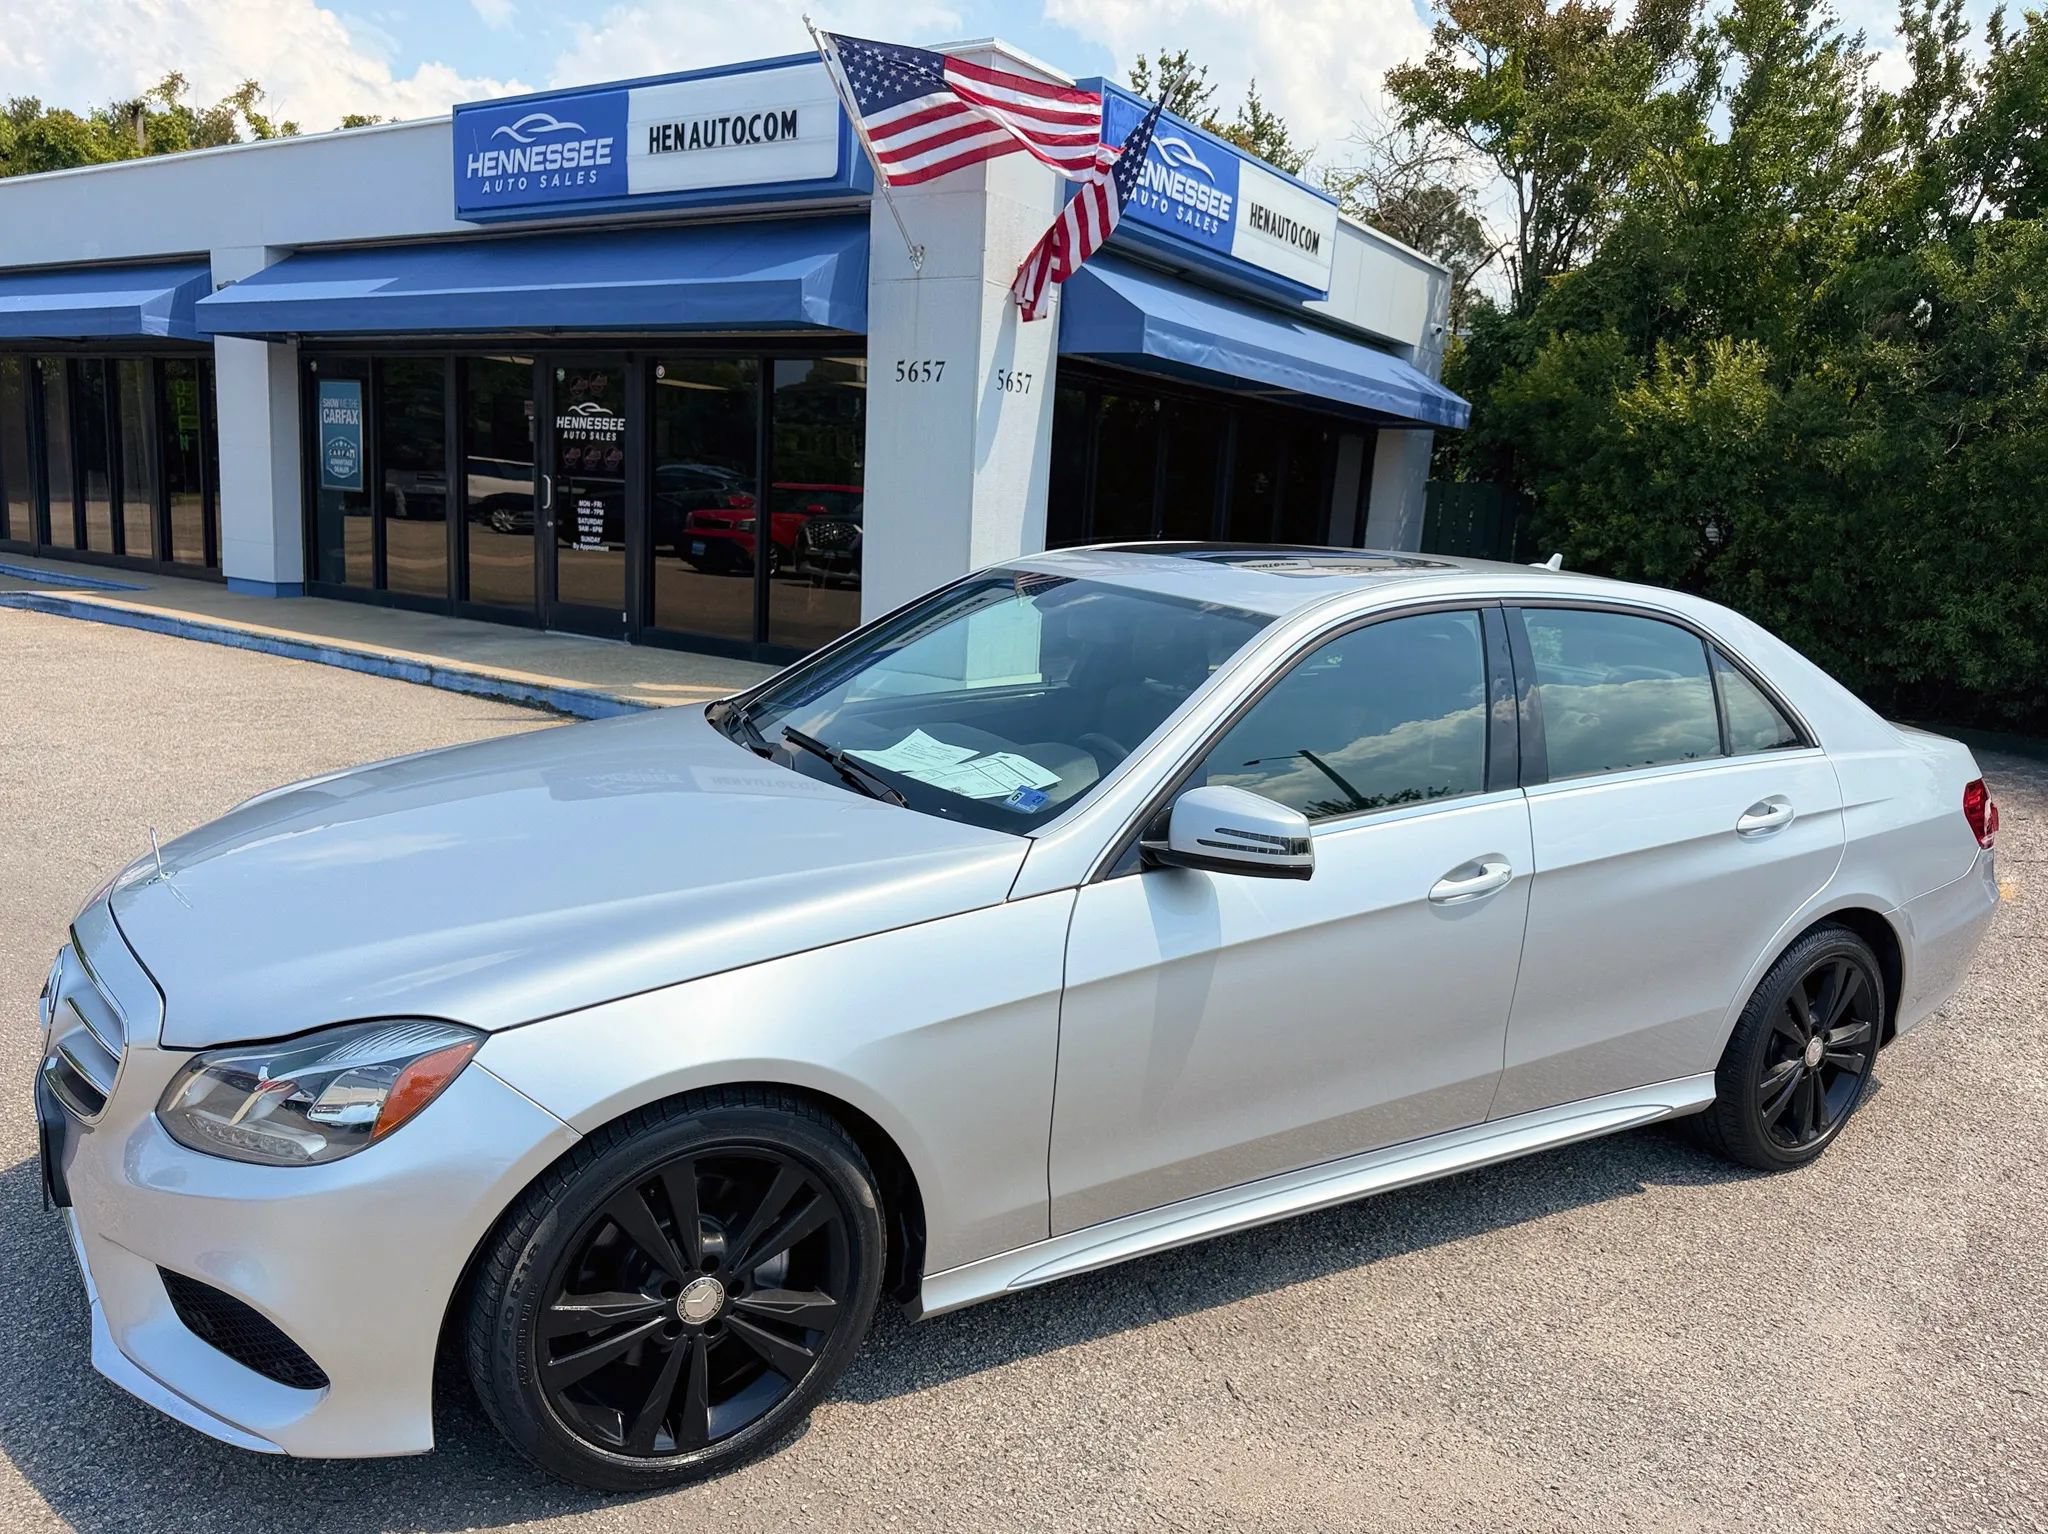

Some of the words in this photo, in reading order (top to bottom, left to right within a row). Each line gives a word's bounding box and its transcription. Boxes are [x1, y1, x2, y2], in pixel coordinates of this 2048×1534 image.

[648, 110, 798, 154] HENAUTO.COM
[466, 137, 614, 179] HENNESSEE
[481, 176, 529, 194] AUTO
[539, 169, 598, 188] SALES
[1136, 158, 1232, 222] ENNESSEE
[1130, 187, 1169, 214] AUTO
[1176, 205, 1219, 234] SALES
[1249, 202, 1321, 255] HENAUTO.COM
[895, 359, 946, 383] 5657
[996, 367, 1033, 395] 5657
[323, 398, 339, 408] SHOW
[323, 408, 359, 425] CARFAX
[556, 416, 626, 431] HENNESSEE
[563, 430, 586, 440] AUTO
[589, 431, 617, 441] SALES
[577, 517, 604, 525] SATURDAY
[572, 542, 579, 551] By
[580, 535, 601, 543] SUNDAY
